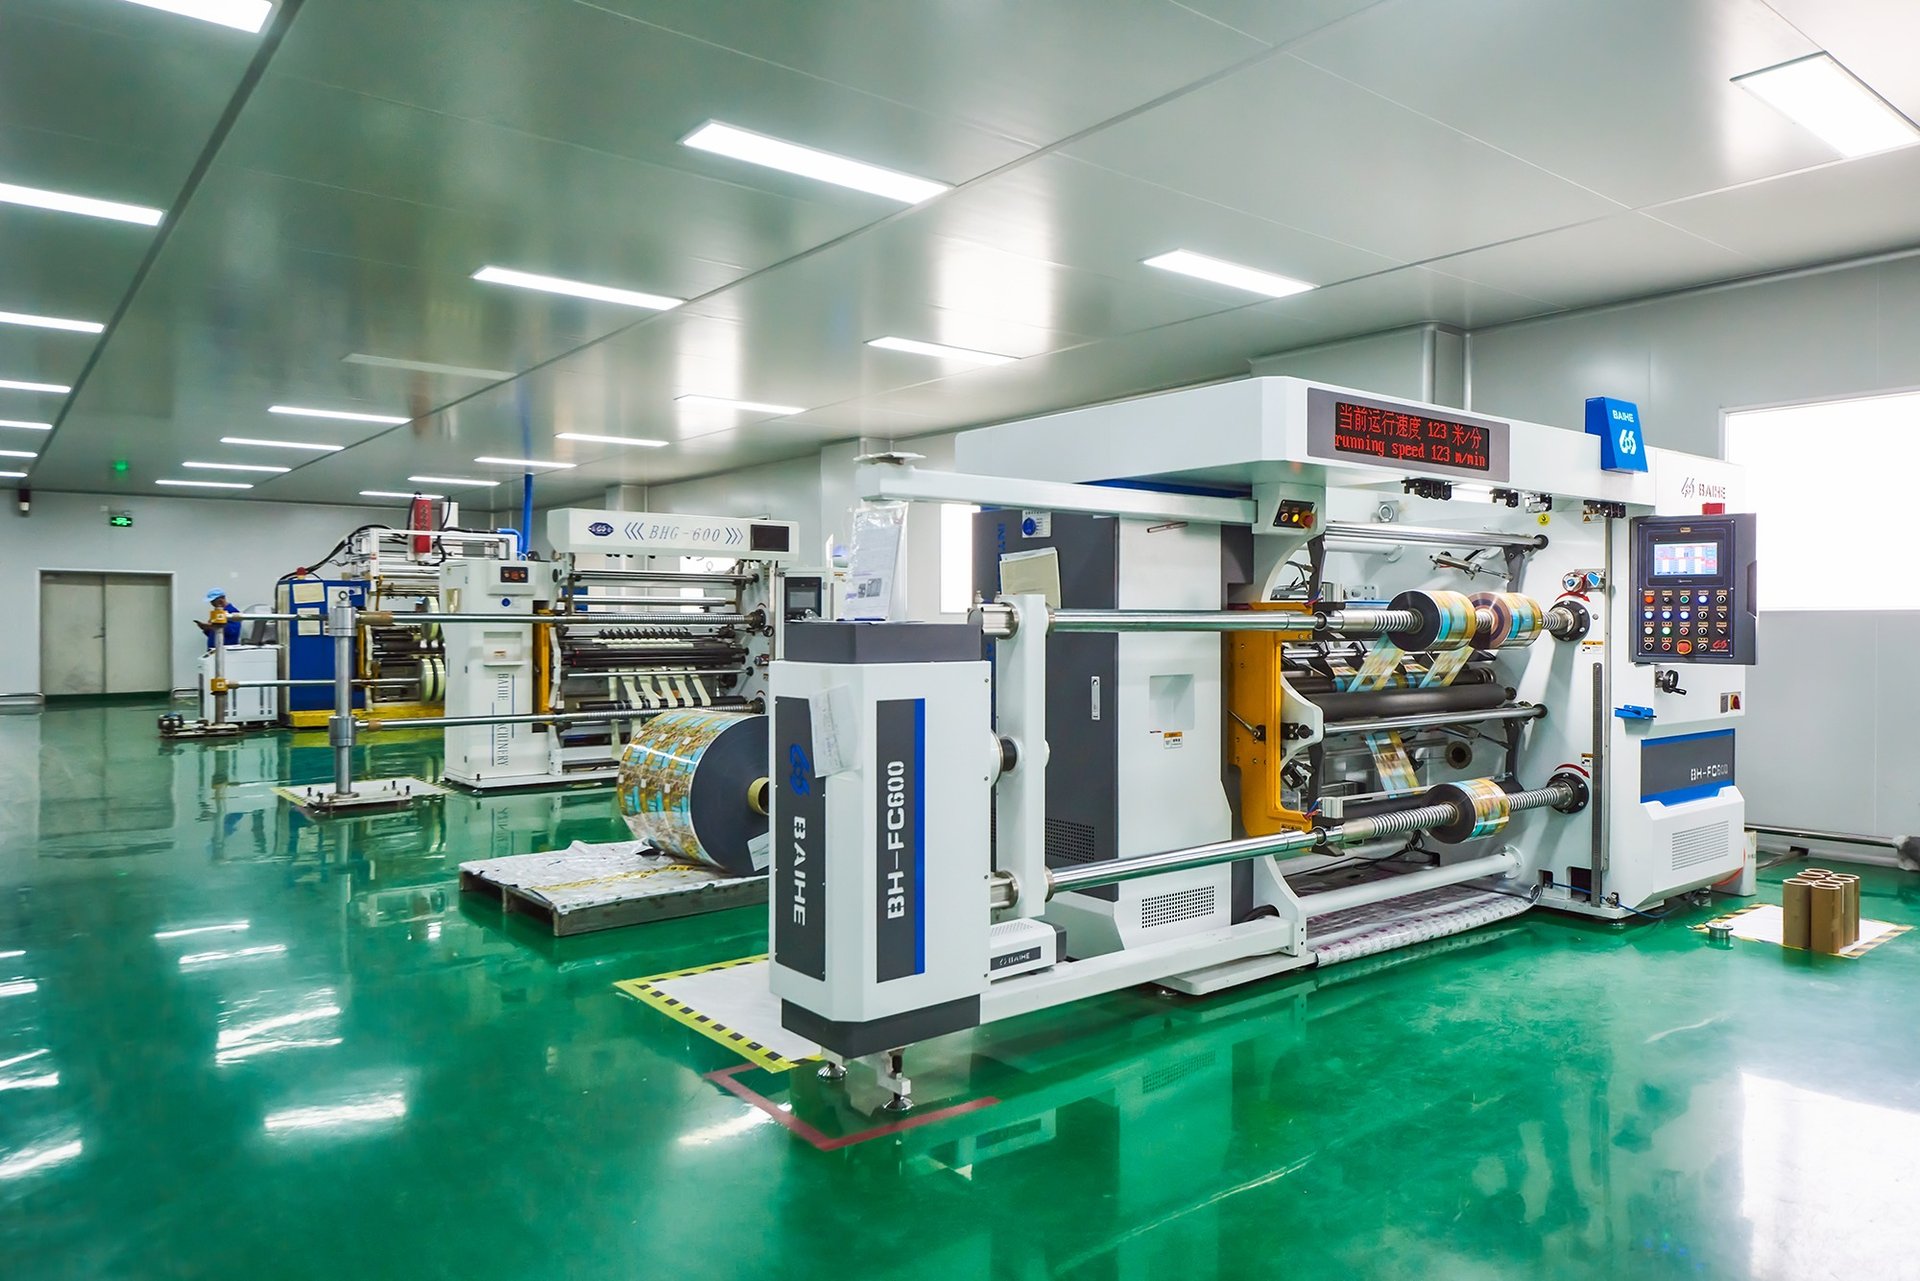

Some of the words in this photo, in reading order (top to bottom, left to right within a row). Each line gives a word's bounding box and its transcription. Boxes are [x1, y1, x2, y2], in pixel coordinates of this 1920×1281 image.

[1340, 404, 1422, 441] 当前运行速度
[1428, 421, 1447, 440] 123
[1452, 424, 1482, 449] 米/分
[1612, 409, 1635, 423] BAIHE
[1335, 434, 1385, 457] running
[1391, 443, 1425, 461] speed
[1431, 444, 1451, 462] 123
[1455, 451, 1486, 467] m/min
[1698, 483, 1726, 500] BAIHE
[1690, 763, 1729, 781] BH-FC600
[887, 760, 905, 920] BH-FC600
[794, 816, 806, 927] BAIHE
